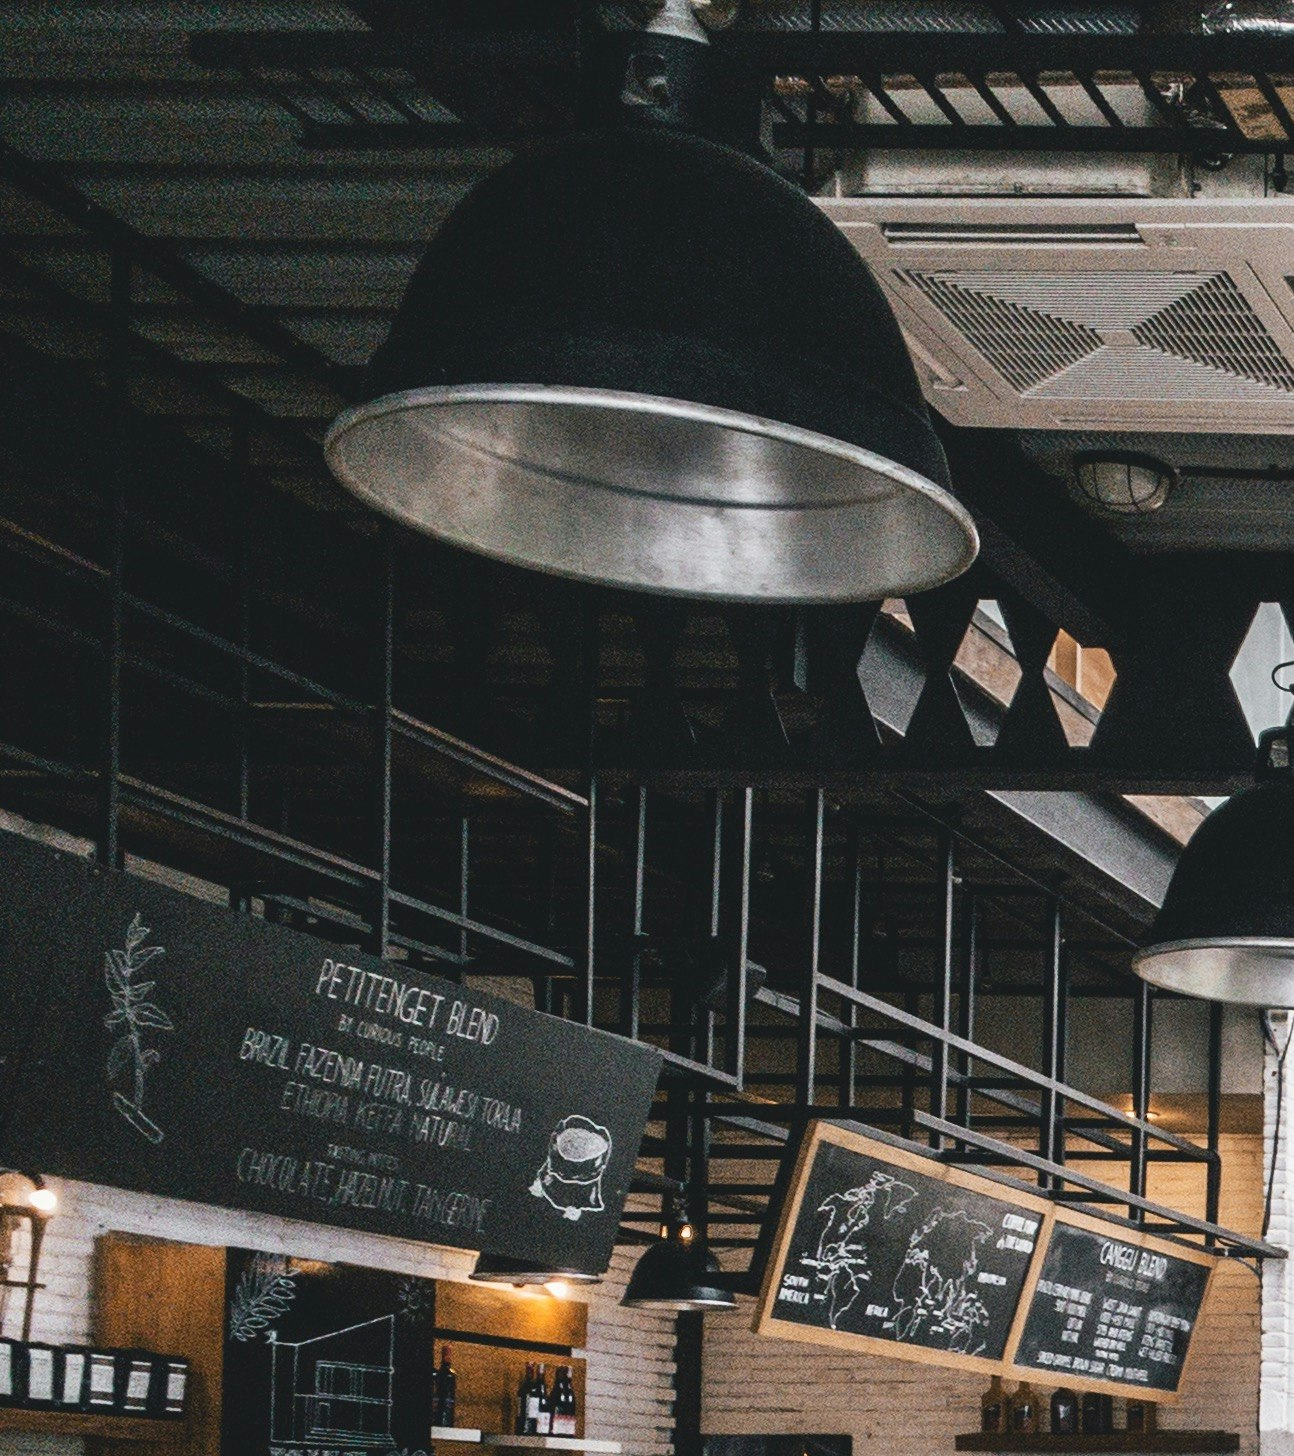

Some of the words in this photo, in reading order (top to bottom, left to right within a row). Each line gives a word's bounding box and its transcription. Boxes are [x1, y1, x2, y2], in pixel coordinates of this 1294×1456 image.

[315, 958, 445, 1028] PETITENGET
[446, 1000, 500, 1045] BLEND
[239, 1027, 290, 1070] BRAZIL
[294, 1043, 364, 1089] FAZENDA
[337, 1014, 354, 1032] BY
[408, 1036, 446, 1062] PEOPLE
[1136, 1252, 1168, 1280] BLEND
